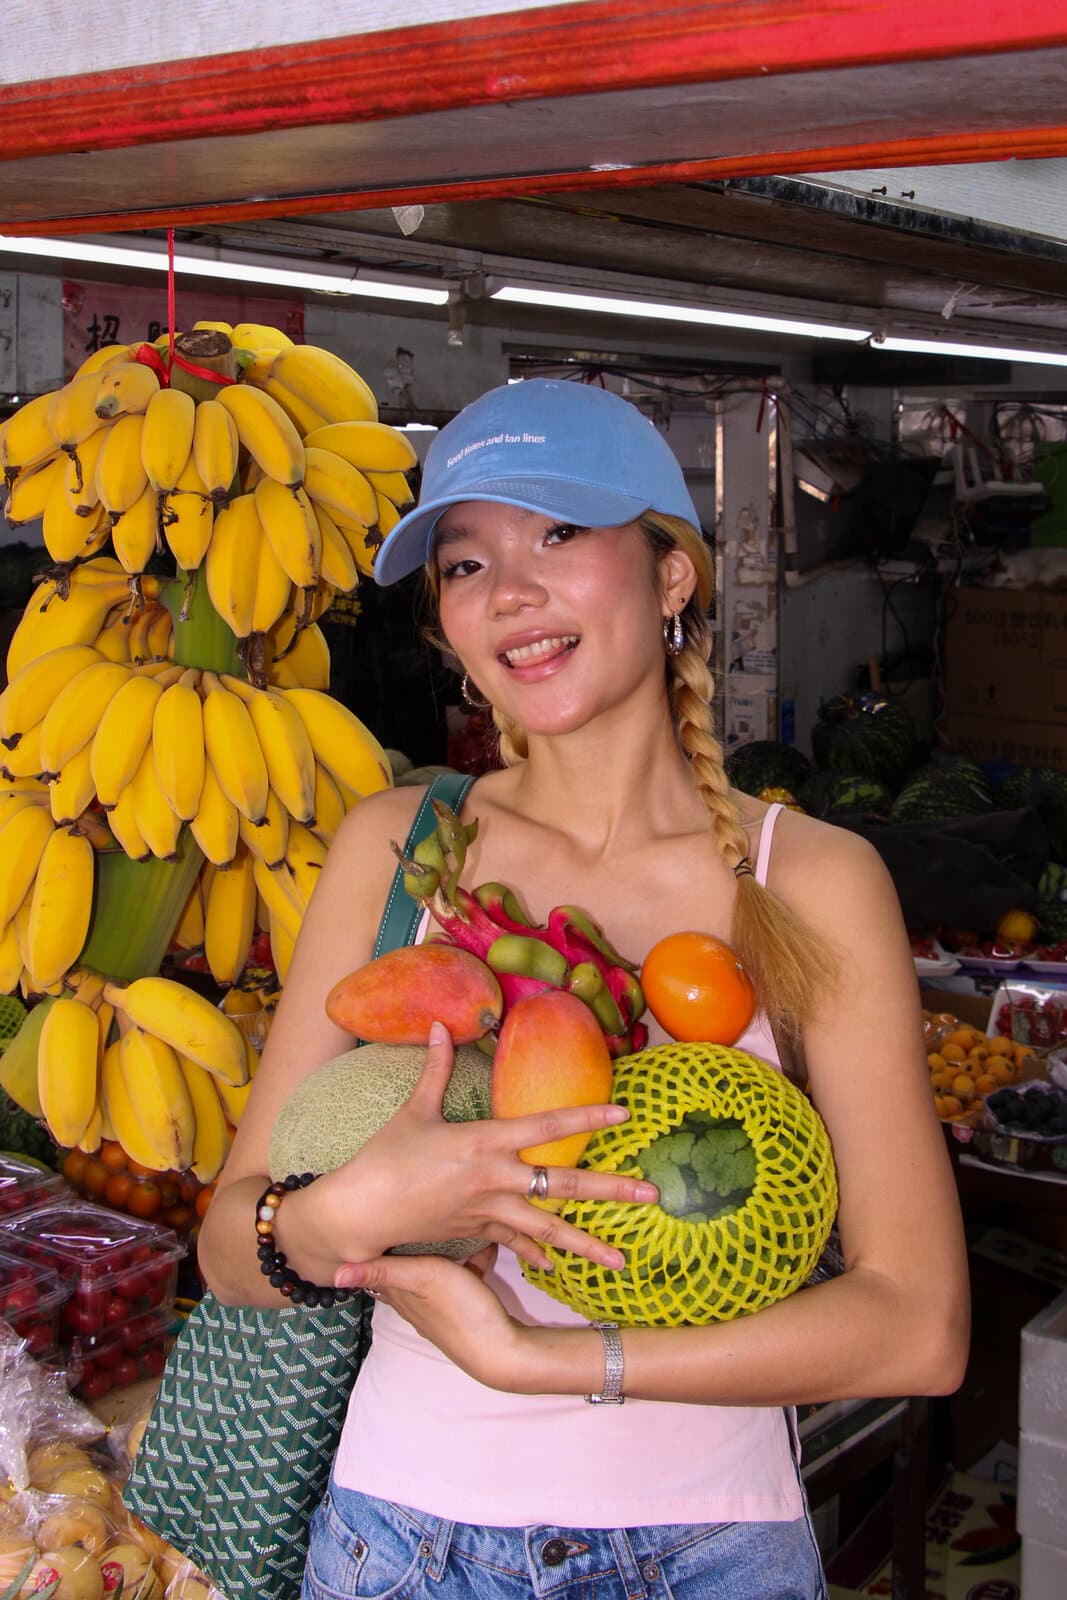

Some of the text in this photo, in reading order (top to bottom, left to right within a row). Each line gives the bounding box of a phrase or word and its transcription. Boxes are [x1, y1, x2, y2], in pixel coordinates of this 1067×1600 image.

[485, 433, 504, 446] and
[505, 433, 521, 443] tan
[522, 432, 546, 444] lines
